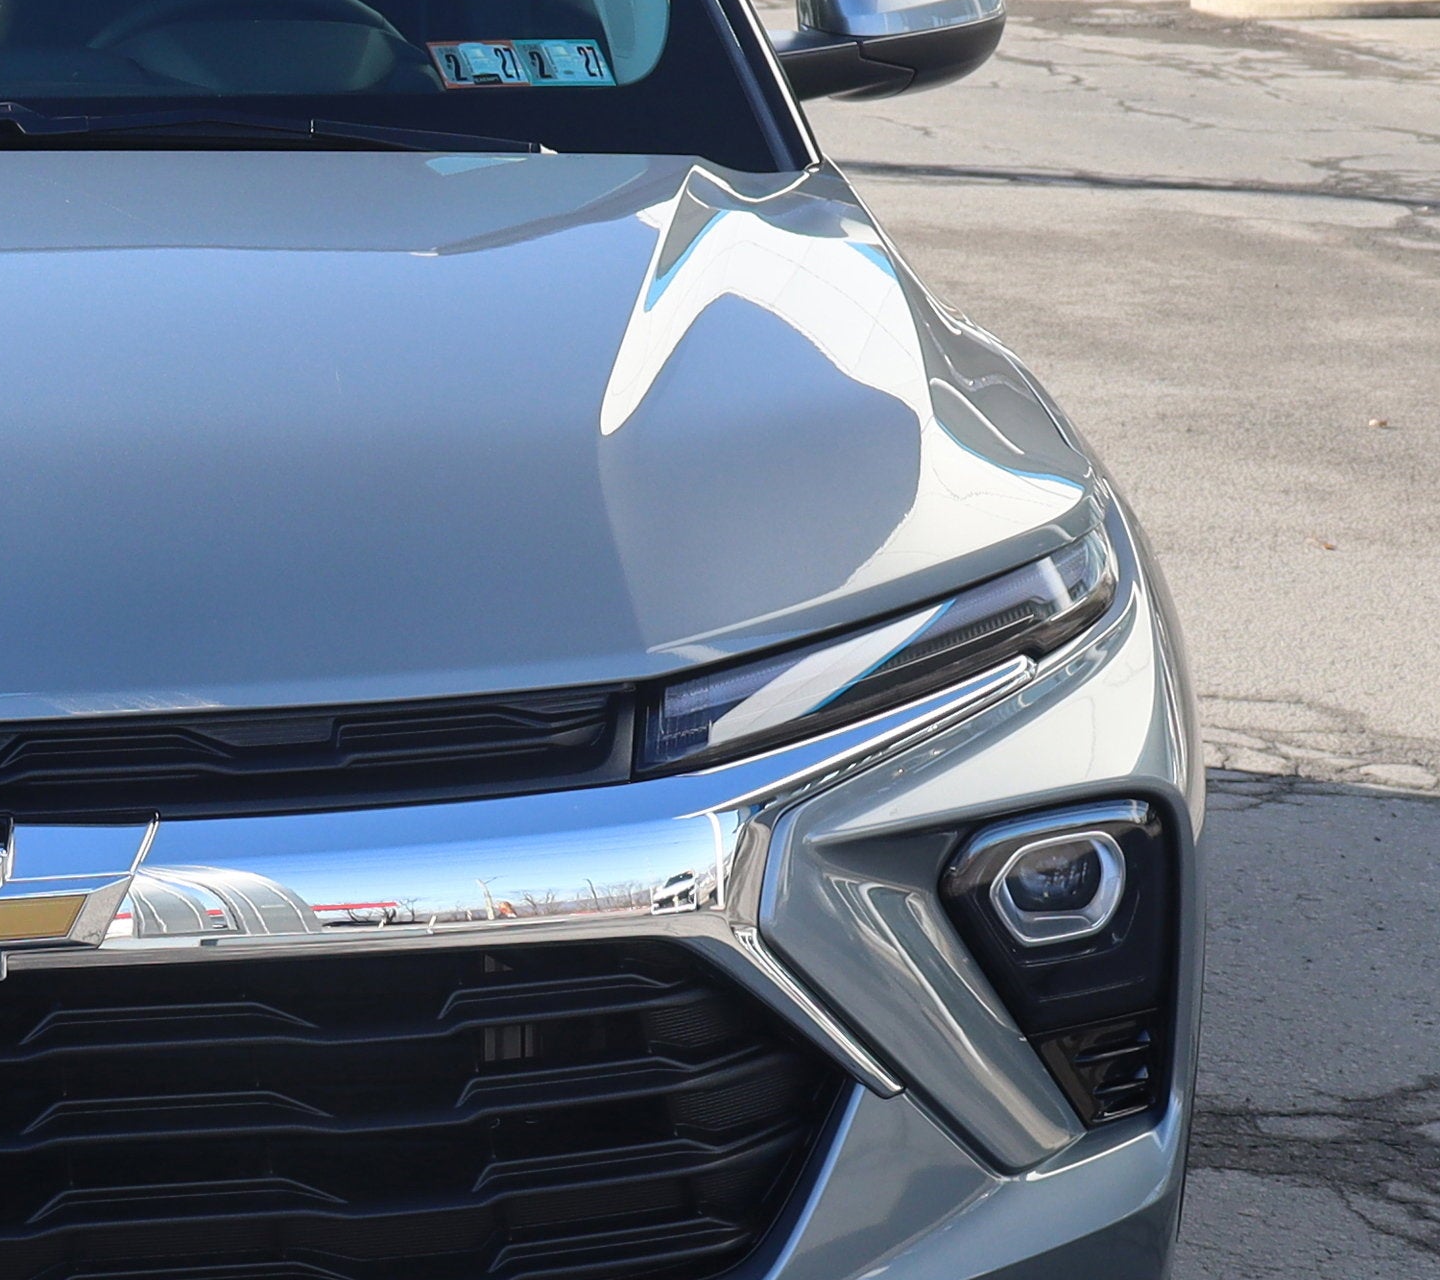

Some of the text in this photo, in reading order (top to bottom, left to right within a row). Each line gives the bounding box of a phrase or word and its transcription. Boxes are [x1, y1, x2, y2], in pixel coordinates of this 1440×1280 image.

[445, 47, 521, 81] 2 27
[528, 46, 604, 78] 2 27
